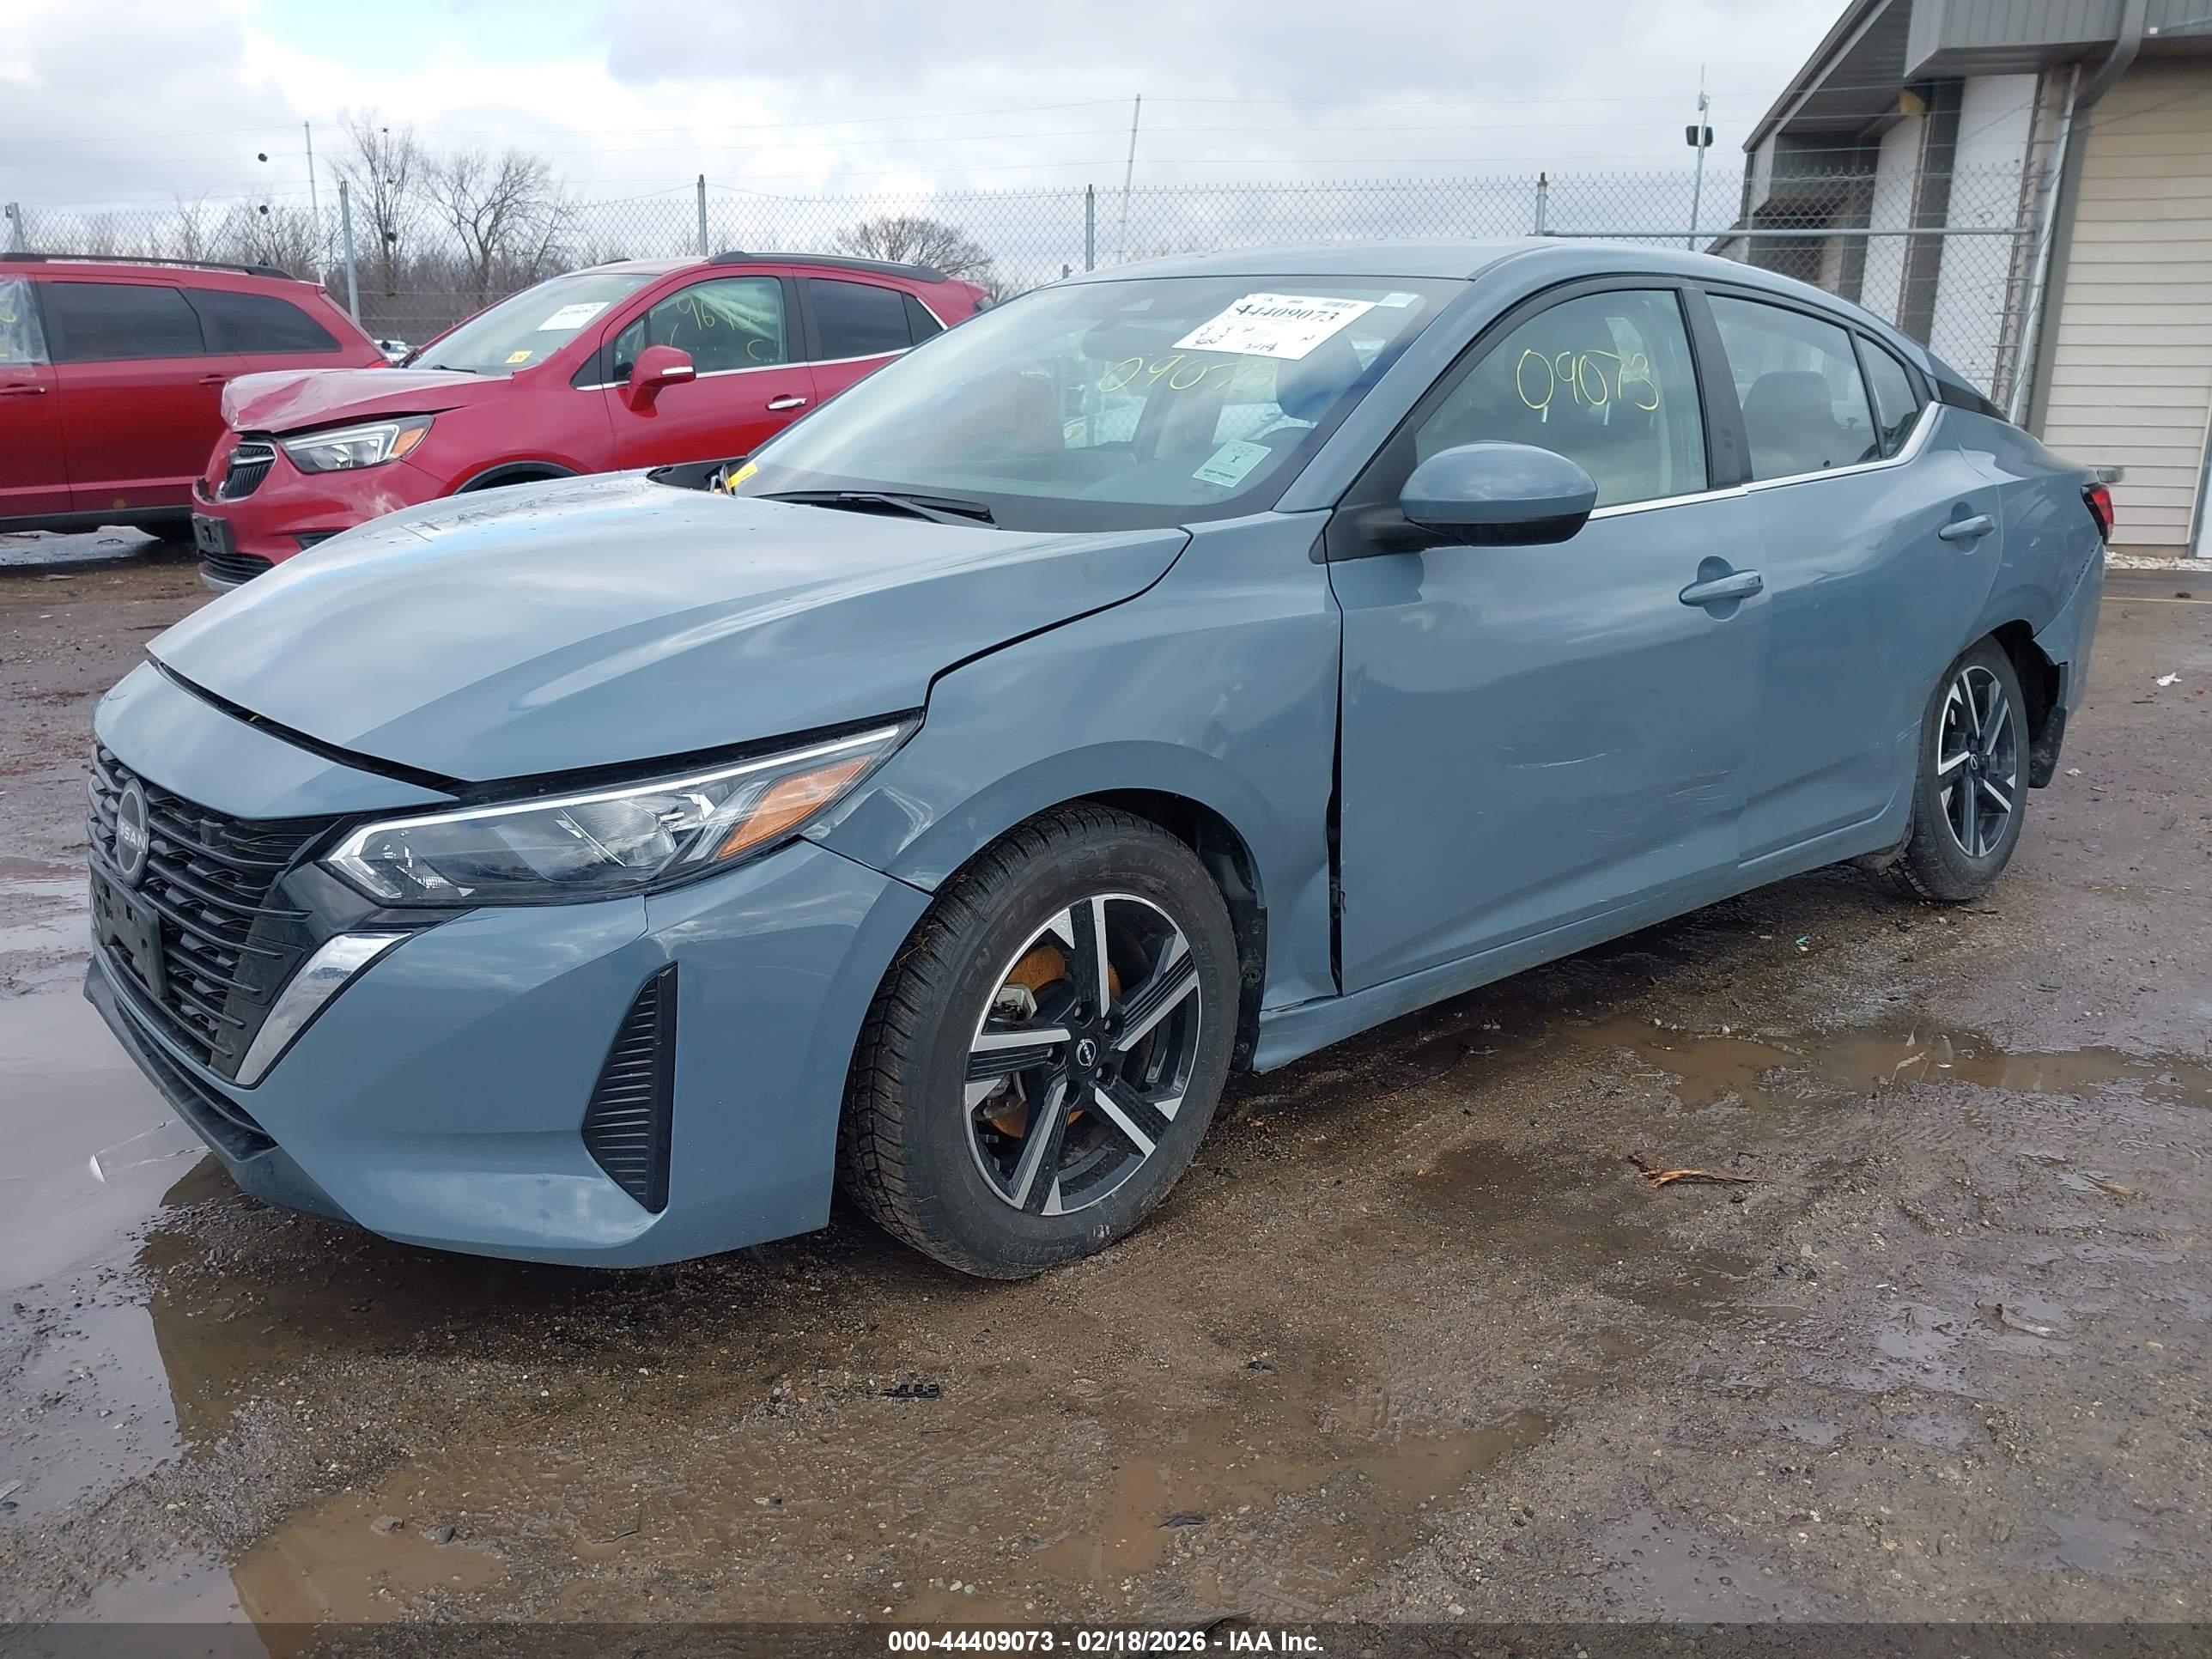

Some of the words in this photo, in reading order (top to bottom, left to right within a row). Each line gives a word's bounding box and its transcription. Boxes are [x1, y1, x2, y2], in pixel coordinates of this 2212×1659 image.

[1234, 303, 1340, 322] 44409073
[1516, 348, 1660, 411] 09073
[118, 822, 146, 849] SSAN
